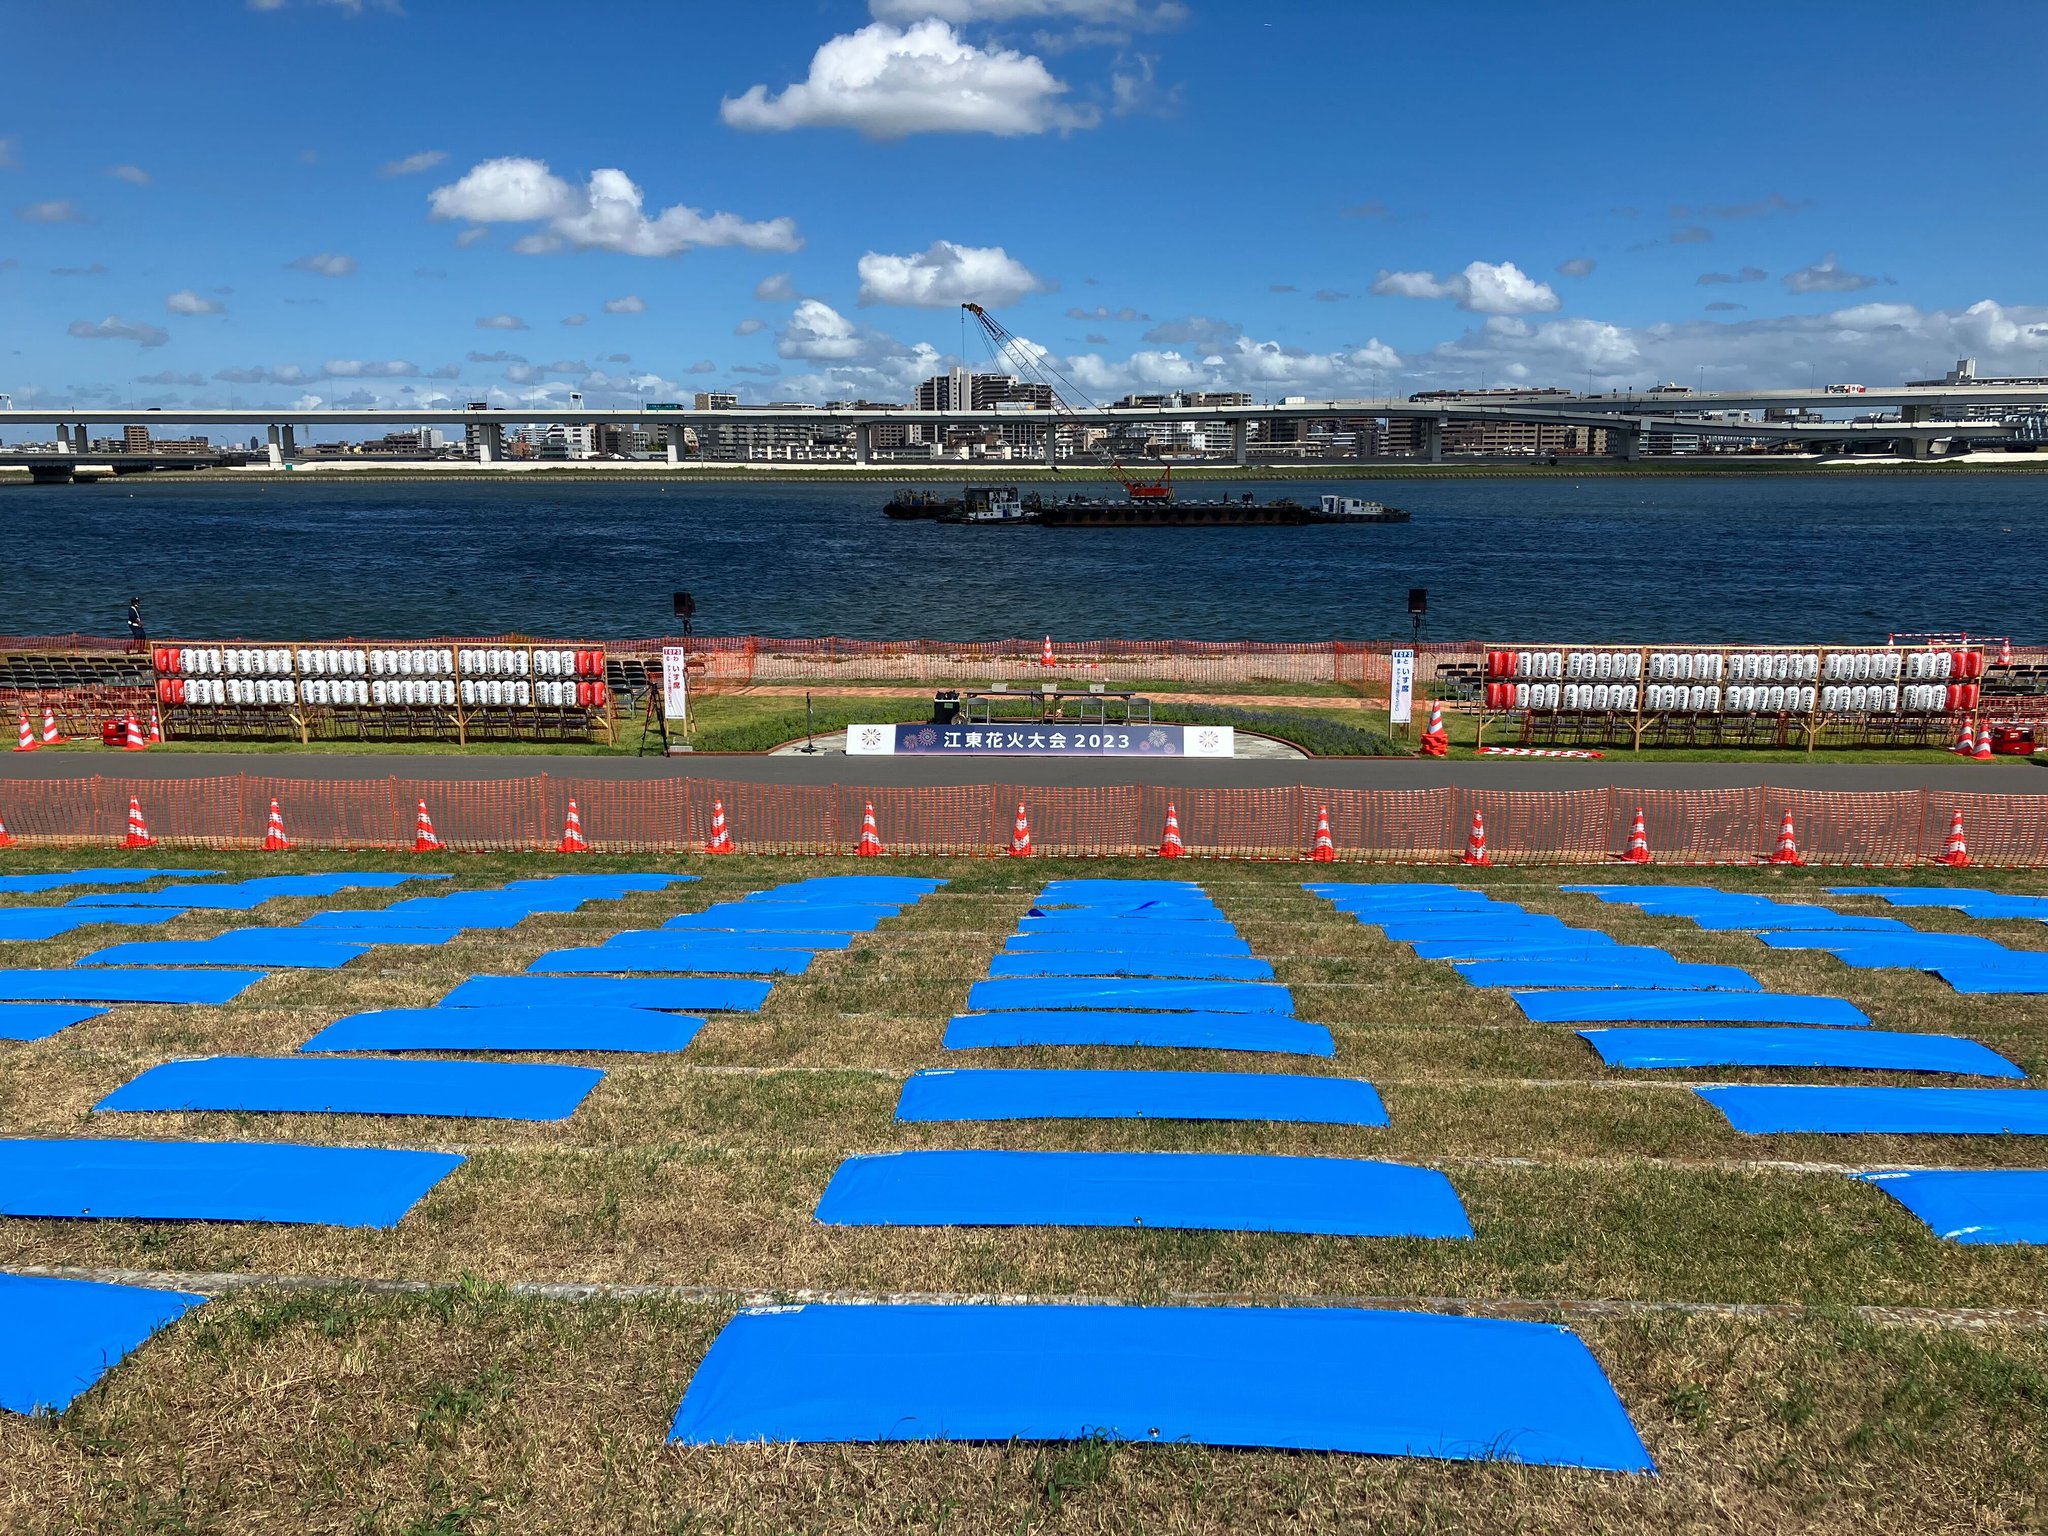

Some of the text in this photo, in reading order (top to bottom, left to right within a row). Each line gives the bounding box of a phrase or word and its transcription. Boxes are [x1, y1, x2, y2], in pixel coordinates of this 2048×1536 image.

[1401, 668, 1410, 693] いす席
[943, 731, 1130, 749] 江東花火大会 2023
